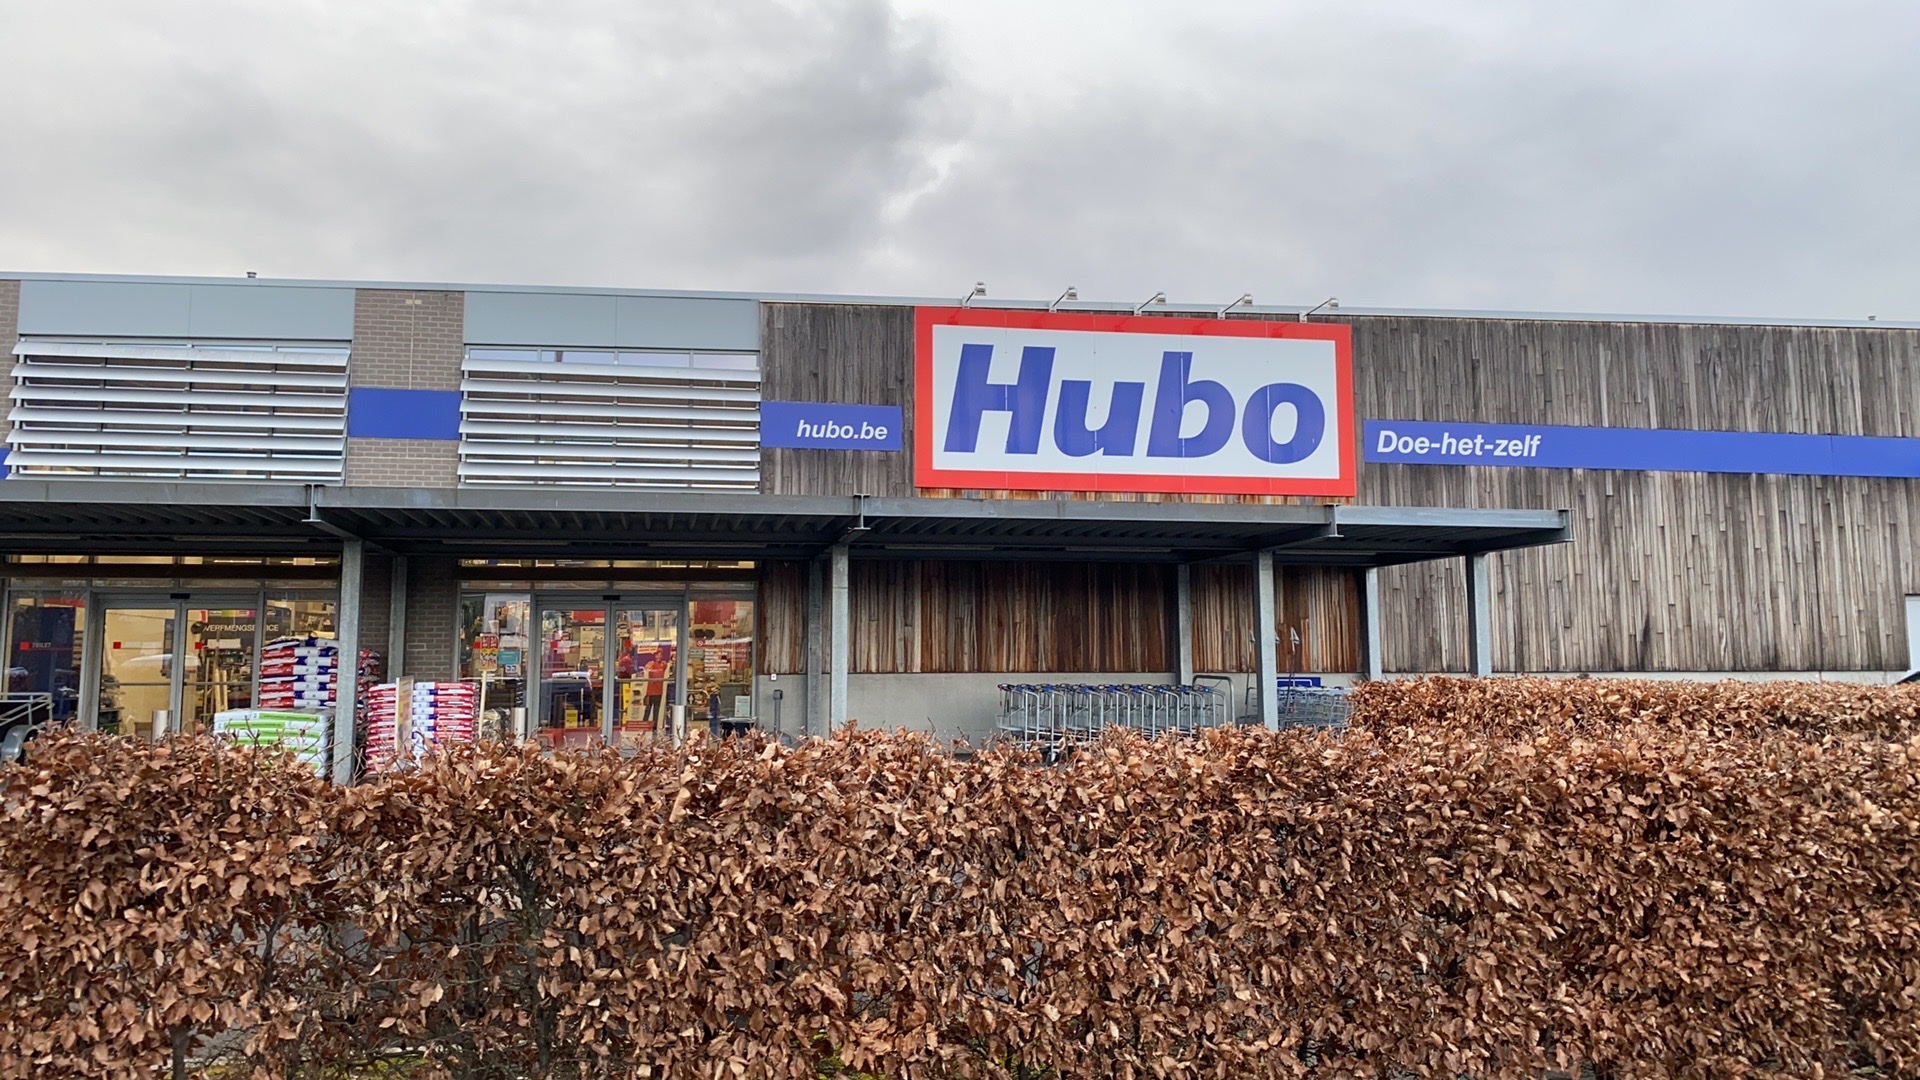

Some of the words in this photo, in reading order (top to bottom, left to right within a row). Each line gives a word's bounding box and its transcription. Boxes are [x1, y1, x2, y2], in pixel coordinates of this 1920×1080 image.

[943, 343, 1326, 464] Hubo
[796, 419, 888, 440] hubo.be
[1376, 429, 1542, 457] Doe-het-zelf
[205, 624, 279, 632] VERFMENGSEICE
